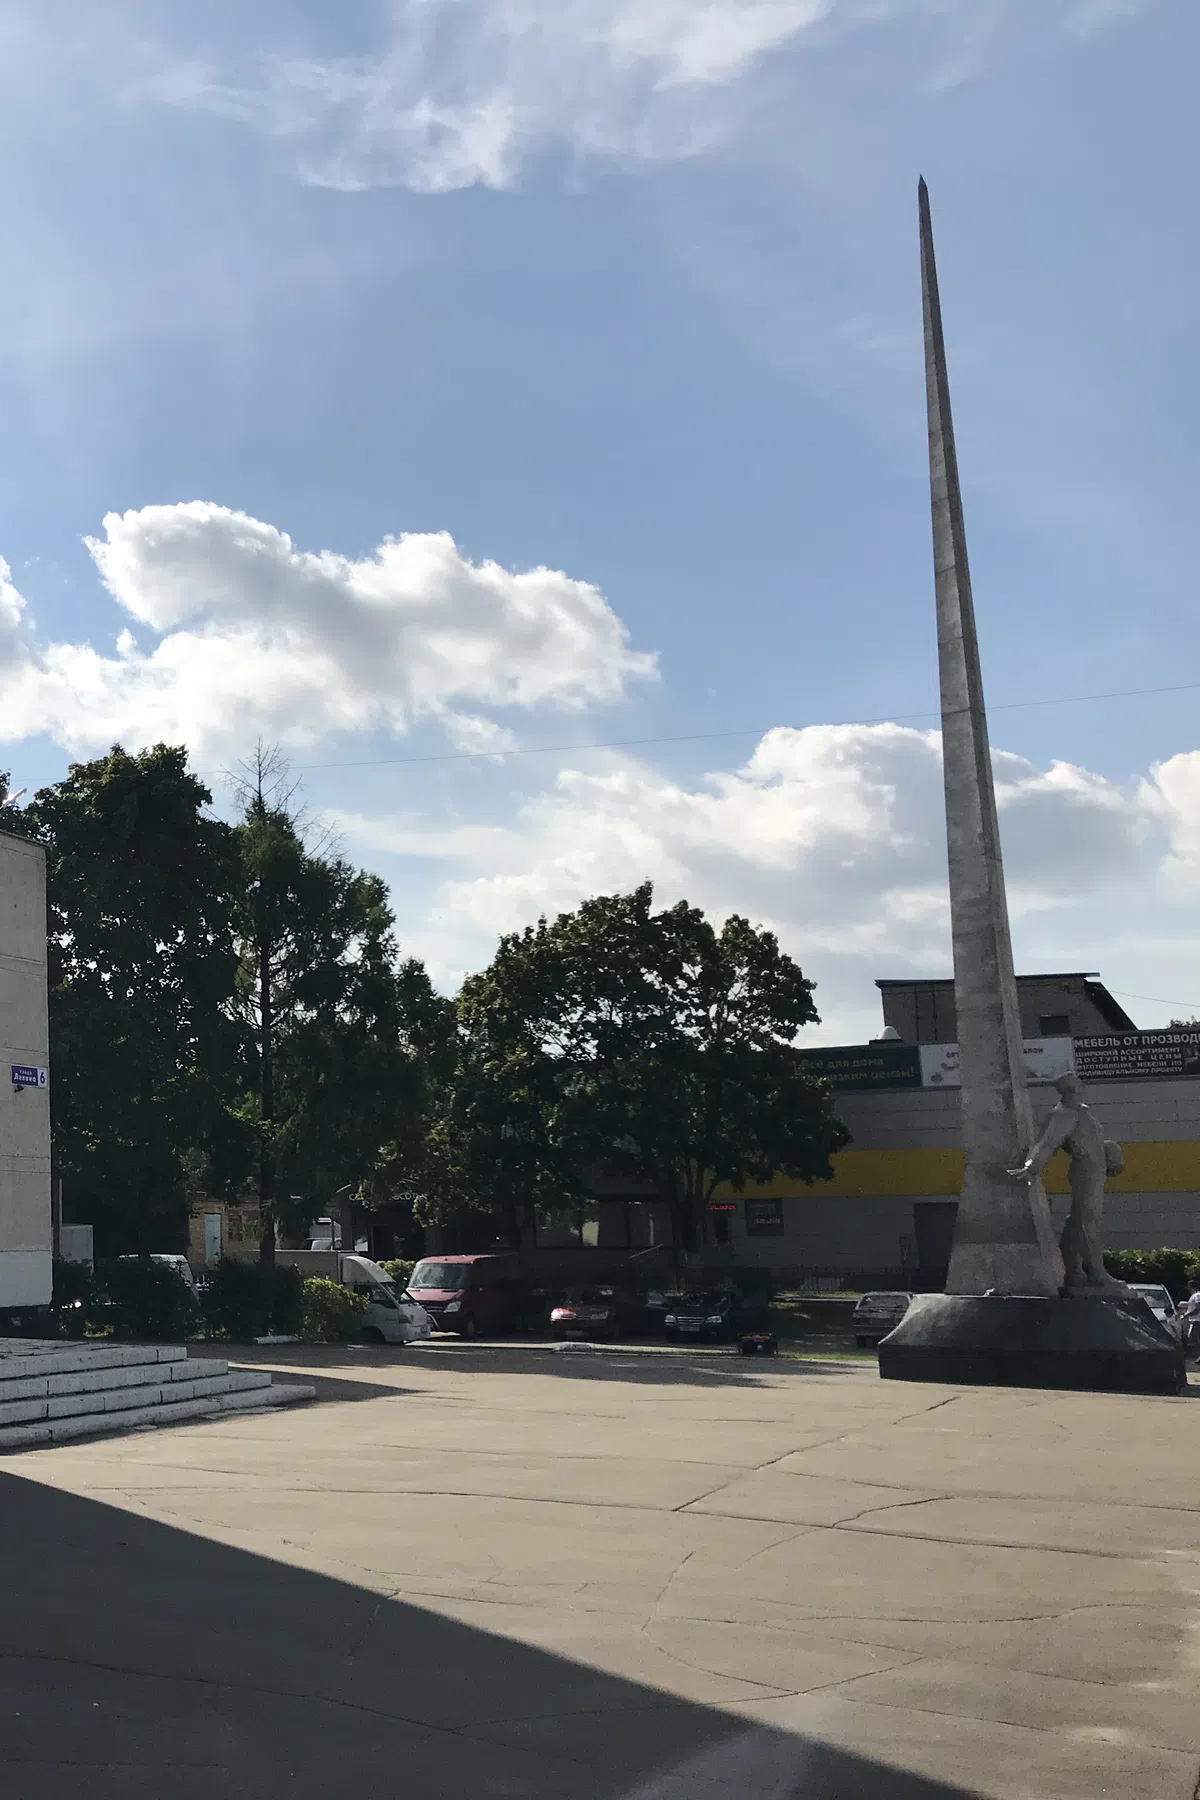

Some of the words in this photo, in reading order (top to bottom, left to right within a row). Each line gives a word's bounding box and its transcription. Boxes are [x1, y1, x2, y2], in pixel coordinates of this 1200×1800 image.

[1074, 1036, 1121, 1049] МЕБЕЛЬ
[1123, 1036, 1139, 1046] ОТ
[1142, 1033, 1200, 1045] ПРОЗВОД
[1075, 1048, 1119, 1058] ШИРОКИЙ
[1120, 1046, 1181, 1055] АССОРТИМЕНТ
[1075, 1055, 1143, 1064] ДОСТУПНЫЕ
[1150, 1053, 1182, 1061] ЦЕНЫ
[1137, 1060, 1167, 1068] МЕБЕЛИ
[1151, 1066, 1183, 1074] ПРОЕКТУ
[40, 1072, 46, 1084] 6
